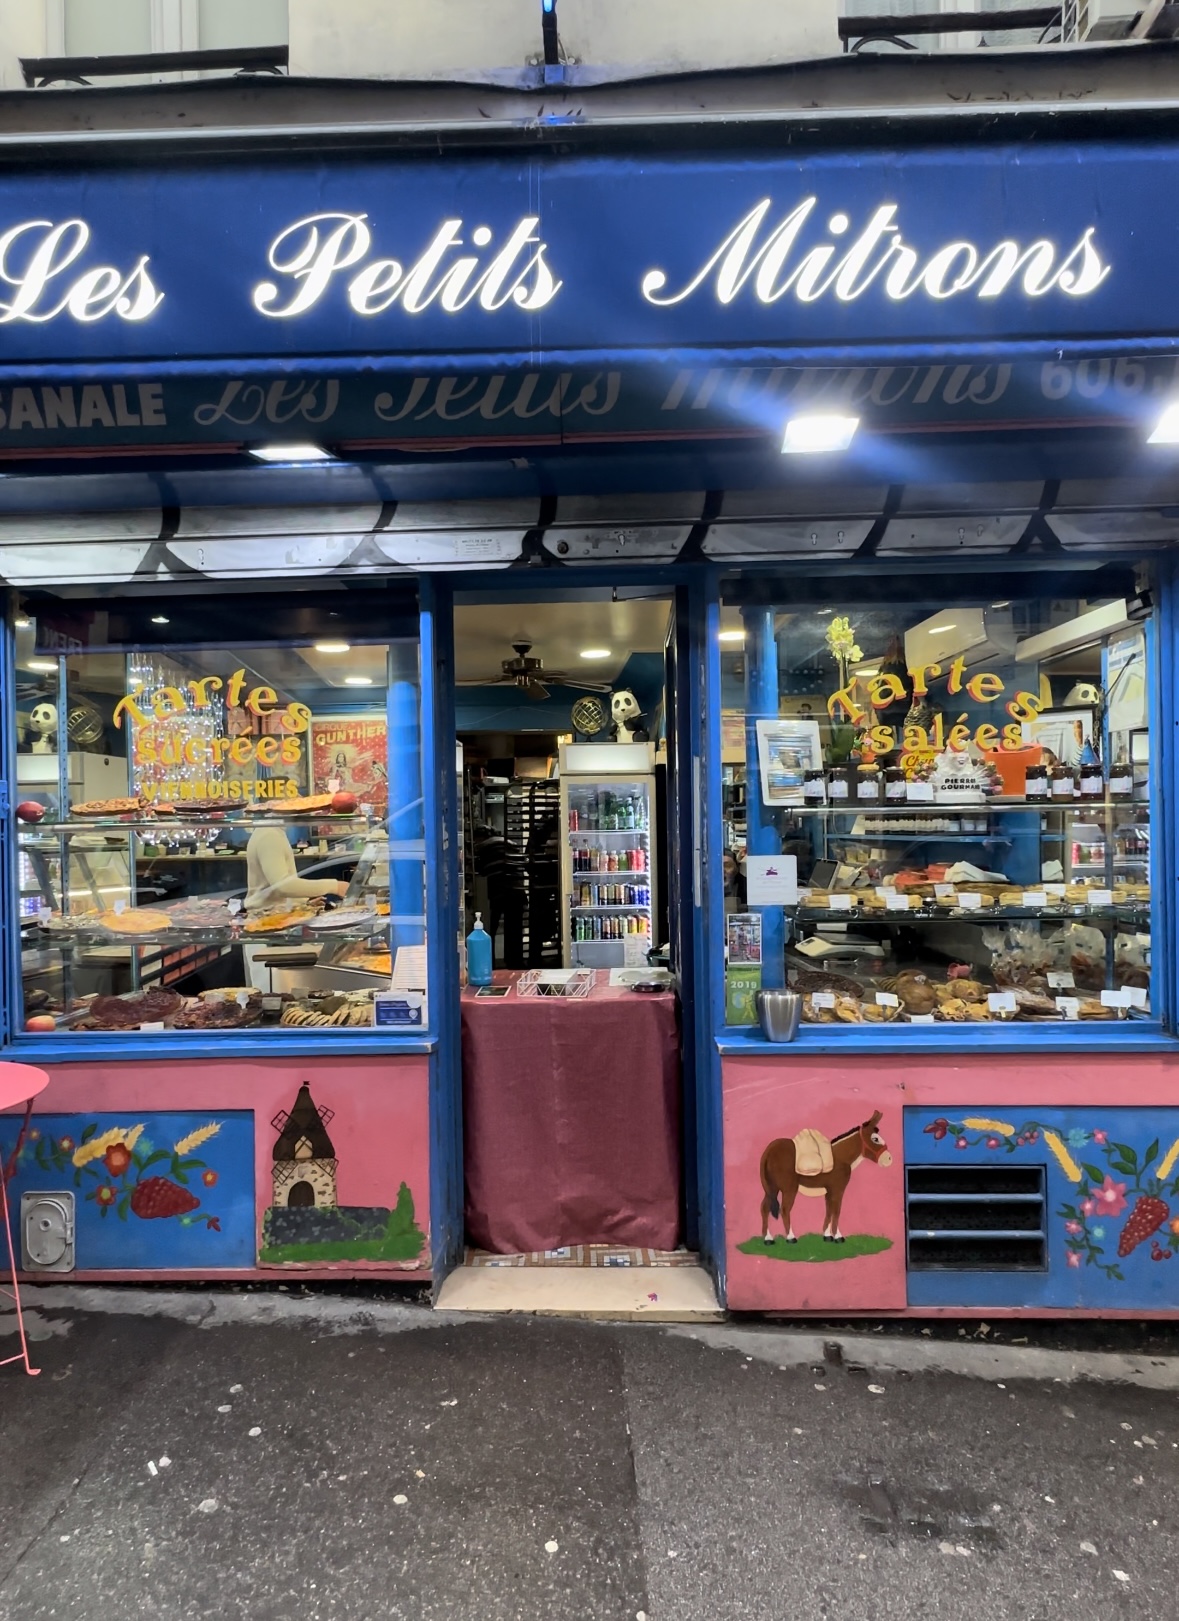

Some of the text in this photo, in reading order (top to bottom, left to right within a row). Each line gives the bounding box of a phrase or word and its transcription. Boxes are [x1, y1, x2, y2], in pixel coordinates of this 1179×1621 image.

[0, 197, 1111, 322] Les Petits Mitrons
[0, 383, 166, 430] ANALE
[112, 668, 313, 736] Tartes
[827, 655, 1044, 726] Tartes
[136, 727, 302, 767] sucrées
[869, 713, 1024, 754] salées
[141, 779, 300, 801] VIENNOISERIES
